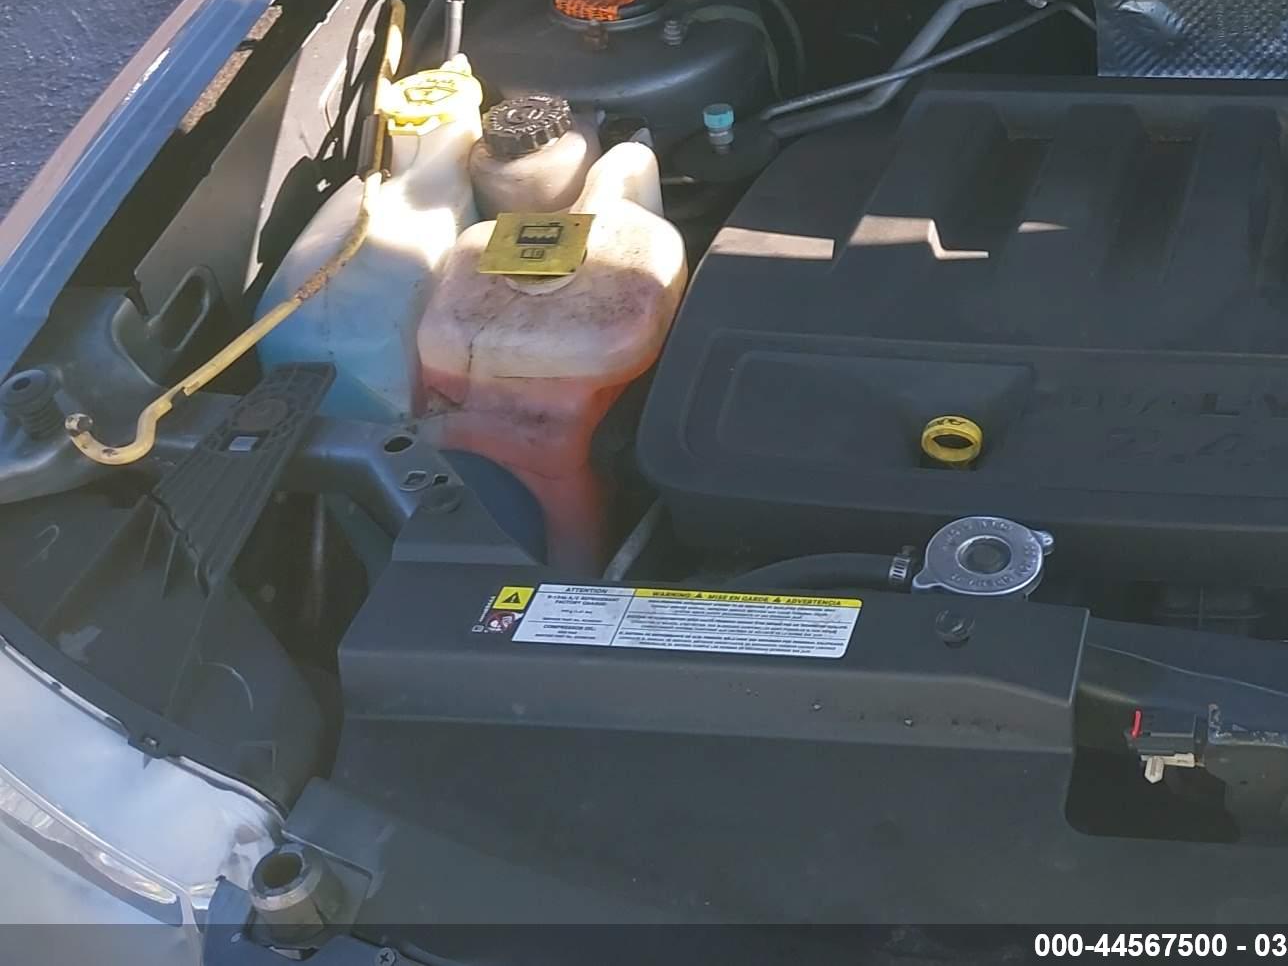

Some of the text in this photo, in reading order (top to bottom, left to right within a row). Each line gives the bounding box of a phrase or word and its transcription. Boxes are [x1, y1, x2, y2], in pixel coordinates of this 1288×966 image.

[565, 587, 609, 595] ATTENTION
[652, 591, 691, 599] WARNING
[785, 597, 842, 607] ADVERTENCIA
